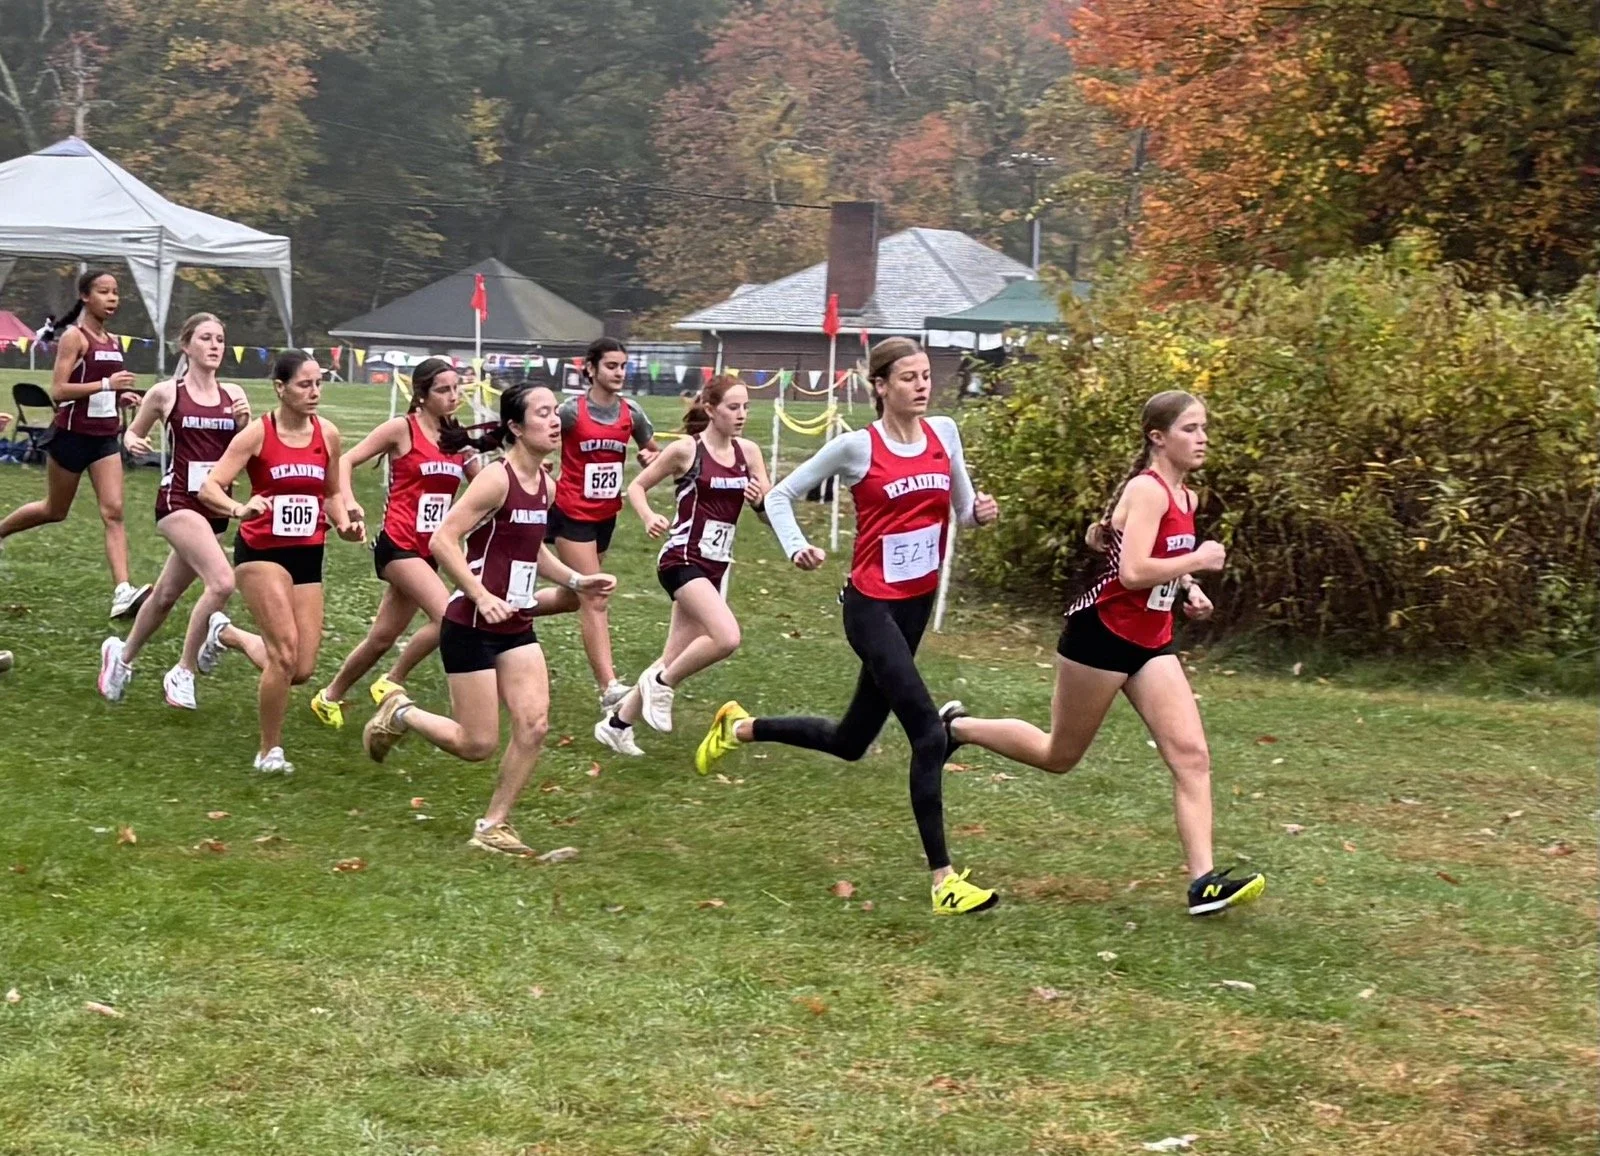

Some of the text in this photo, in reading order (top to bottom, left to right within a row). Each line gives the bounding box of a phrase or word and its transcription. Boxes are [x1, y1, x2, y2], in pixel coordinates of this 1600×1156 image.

[592, 472, 617, 489] 523
[883, 473, 950, 499] READING
[282, 505, 312, 525] 505
[424, 503, 444, 521] 521
[712, 529, 728, 548] 21
[891, 538, 936, 566] 524
